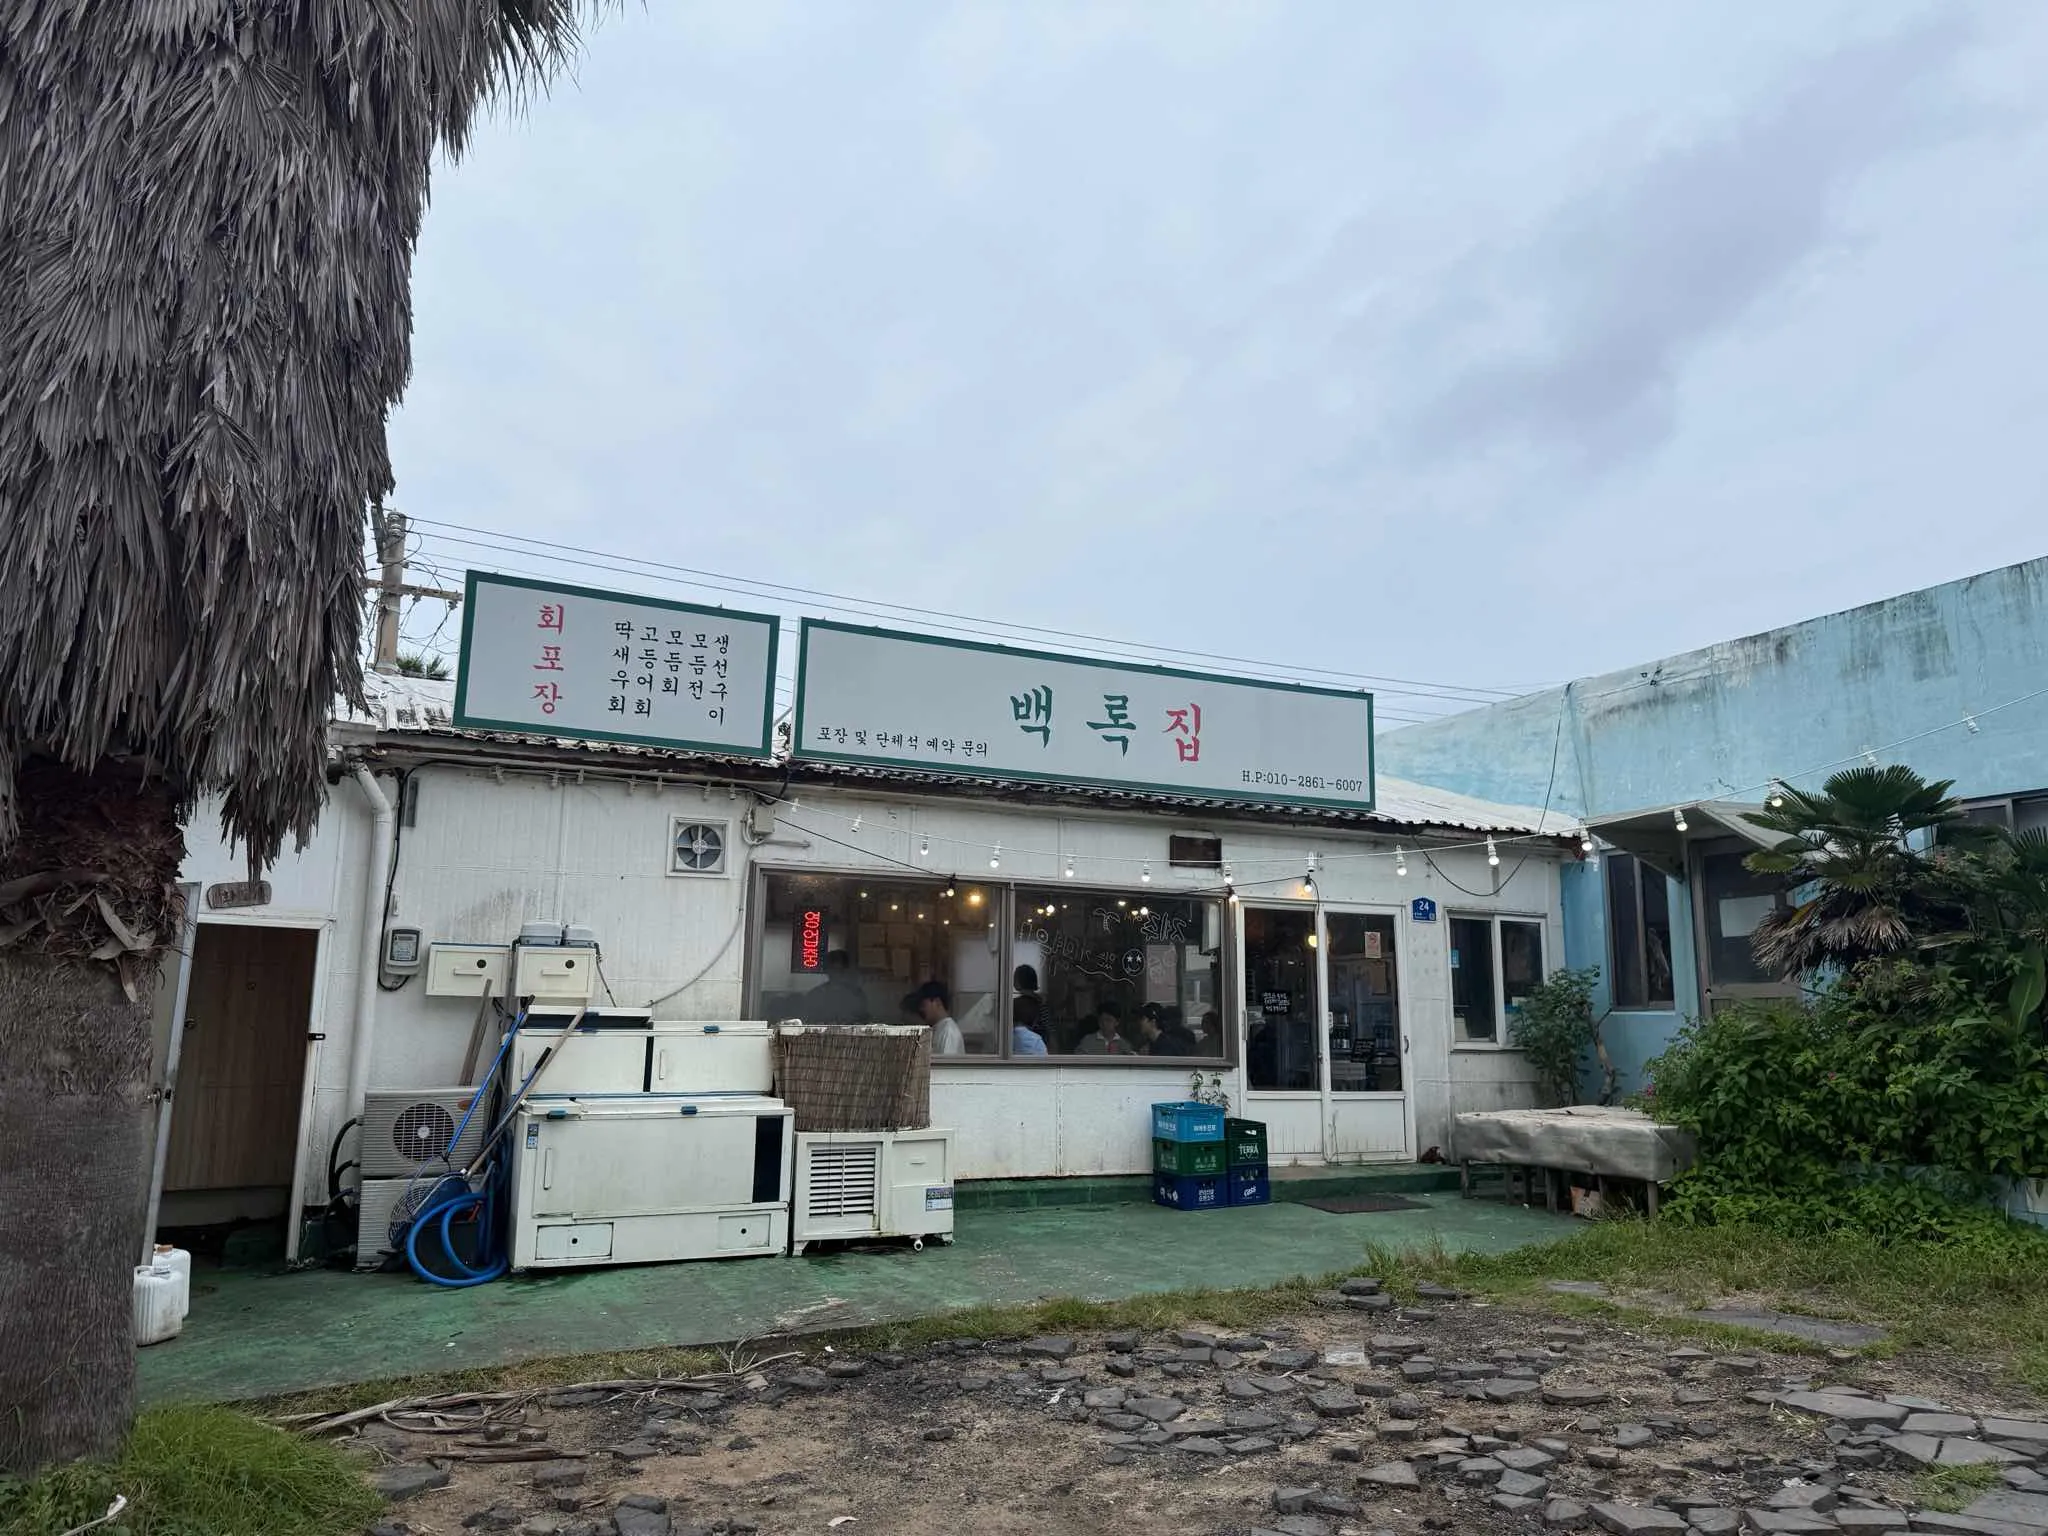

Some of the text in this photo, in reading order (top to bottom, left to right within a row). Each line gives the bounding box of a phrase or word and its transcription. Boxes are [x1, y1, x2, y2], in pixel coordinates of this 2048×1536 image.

[530, 604, 564, 714] 회포장
[608, 621, 635, 715] 딱새우회
[635, 626, 659, 718] 고등어회
[661, 630, 684, 696] 모듬회
[688, 633, 709, 700] 모듬전
[708, 633, 729, 726] 생선구이
[817, 727, 988, 757] 포장 및 단체석 예약 문의
[1010, 684, 1201, 763] 백록집
[1242, 770, 1363, 792] H.P:010-2861-6007
[1418, 900, 1430, 911] 24
[803, 911, 820, 968] 영업중
[1238, 1143, 1259, 1155] TERRA
